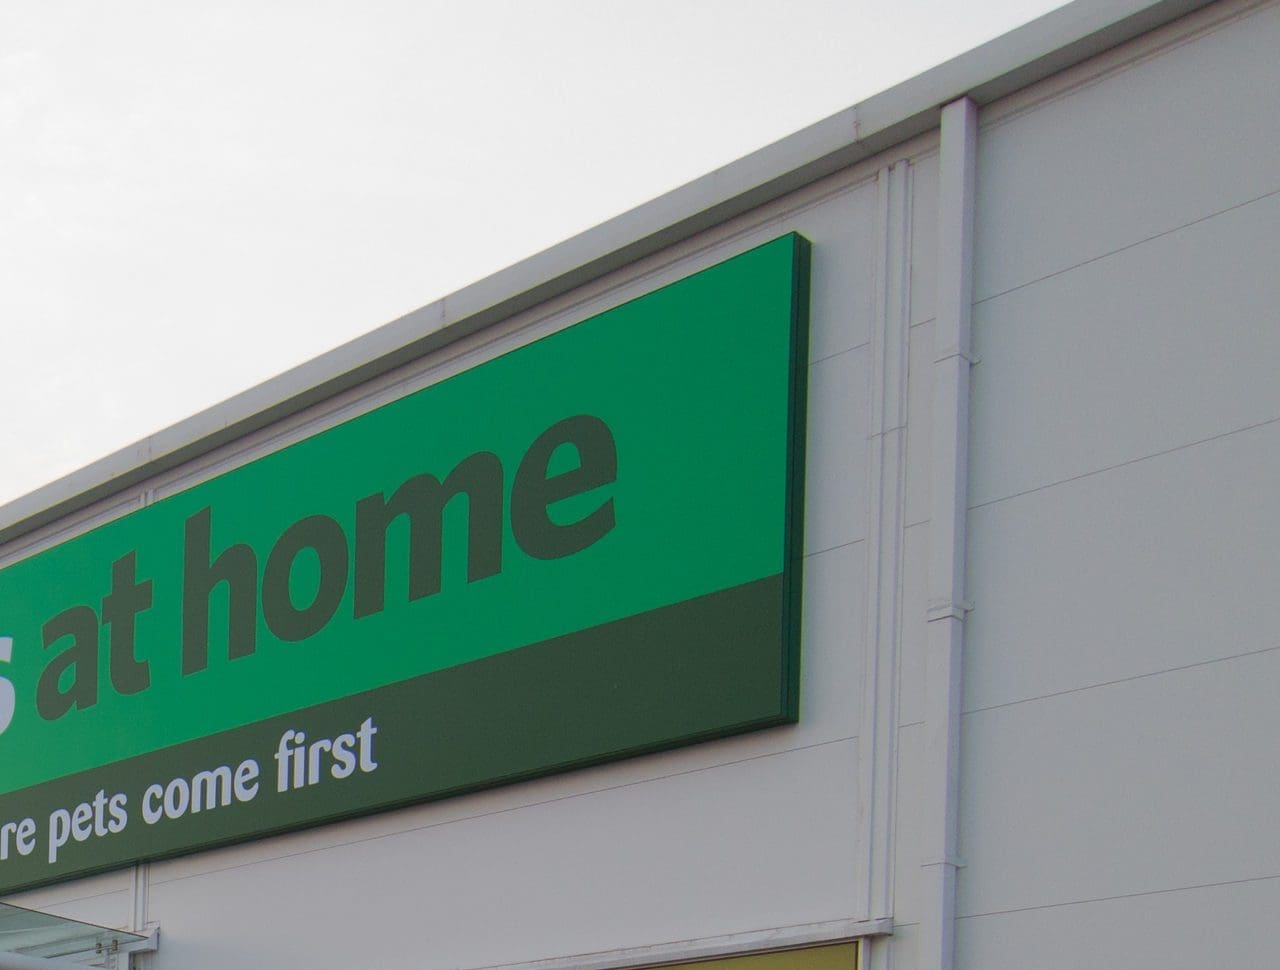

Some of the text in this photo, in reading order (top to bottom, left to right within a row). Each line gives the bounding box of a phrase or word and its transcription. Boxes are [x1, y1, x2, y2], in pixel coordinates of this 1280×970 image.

[35, 549, 153, 721] at
[180, 413, 619, 677] home
[47, 791, 128, 864] pets
[141, 757, 260, 823] come
[274, 716, 379, 794] first
